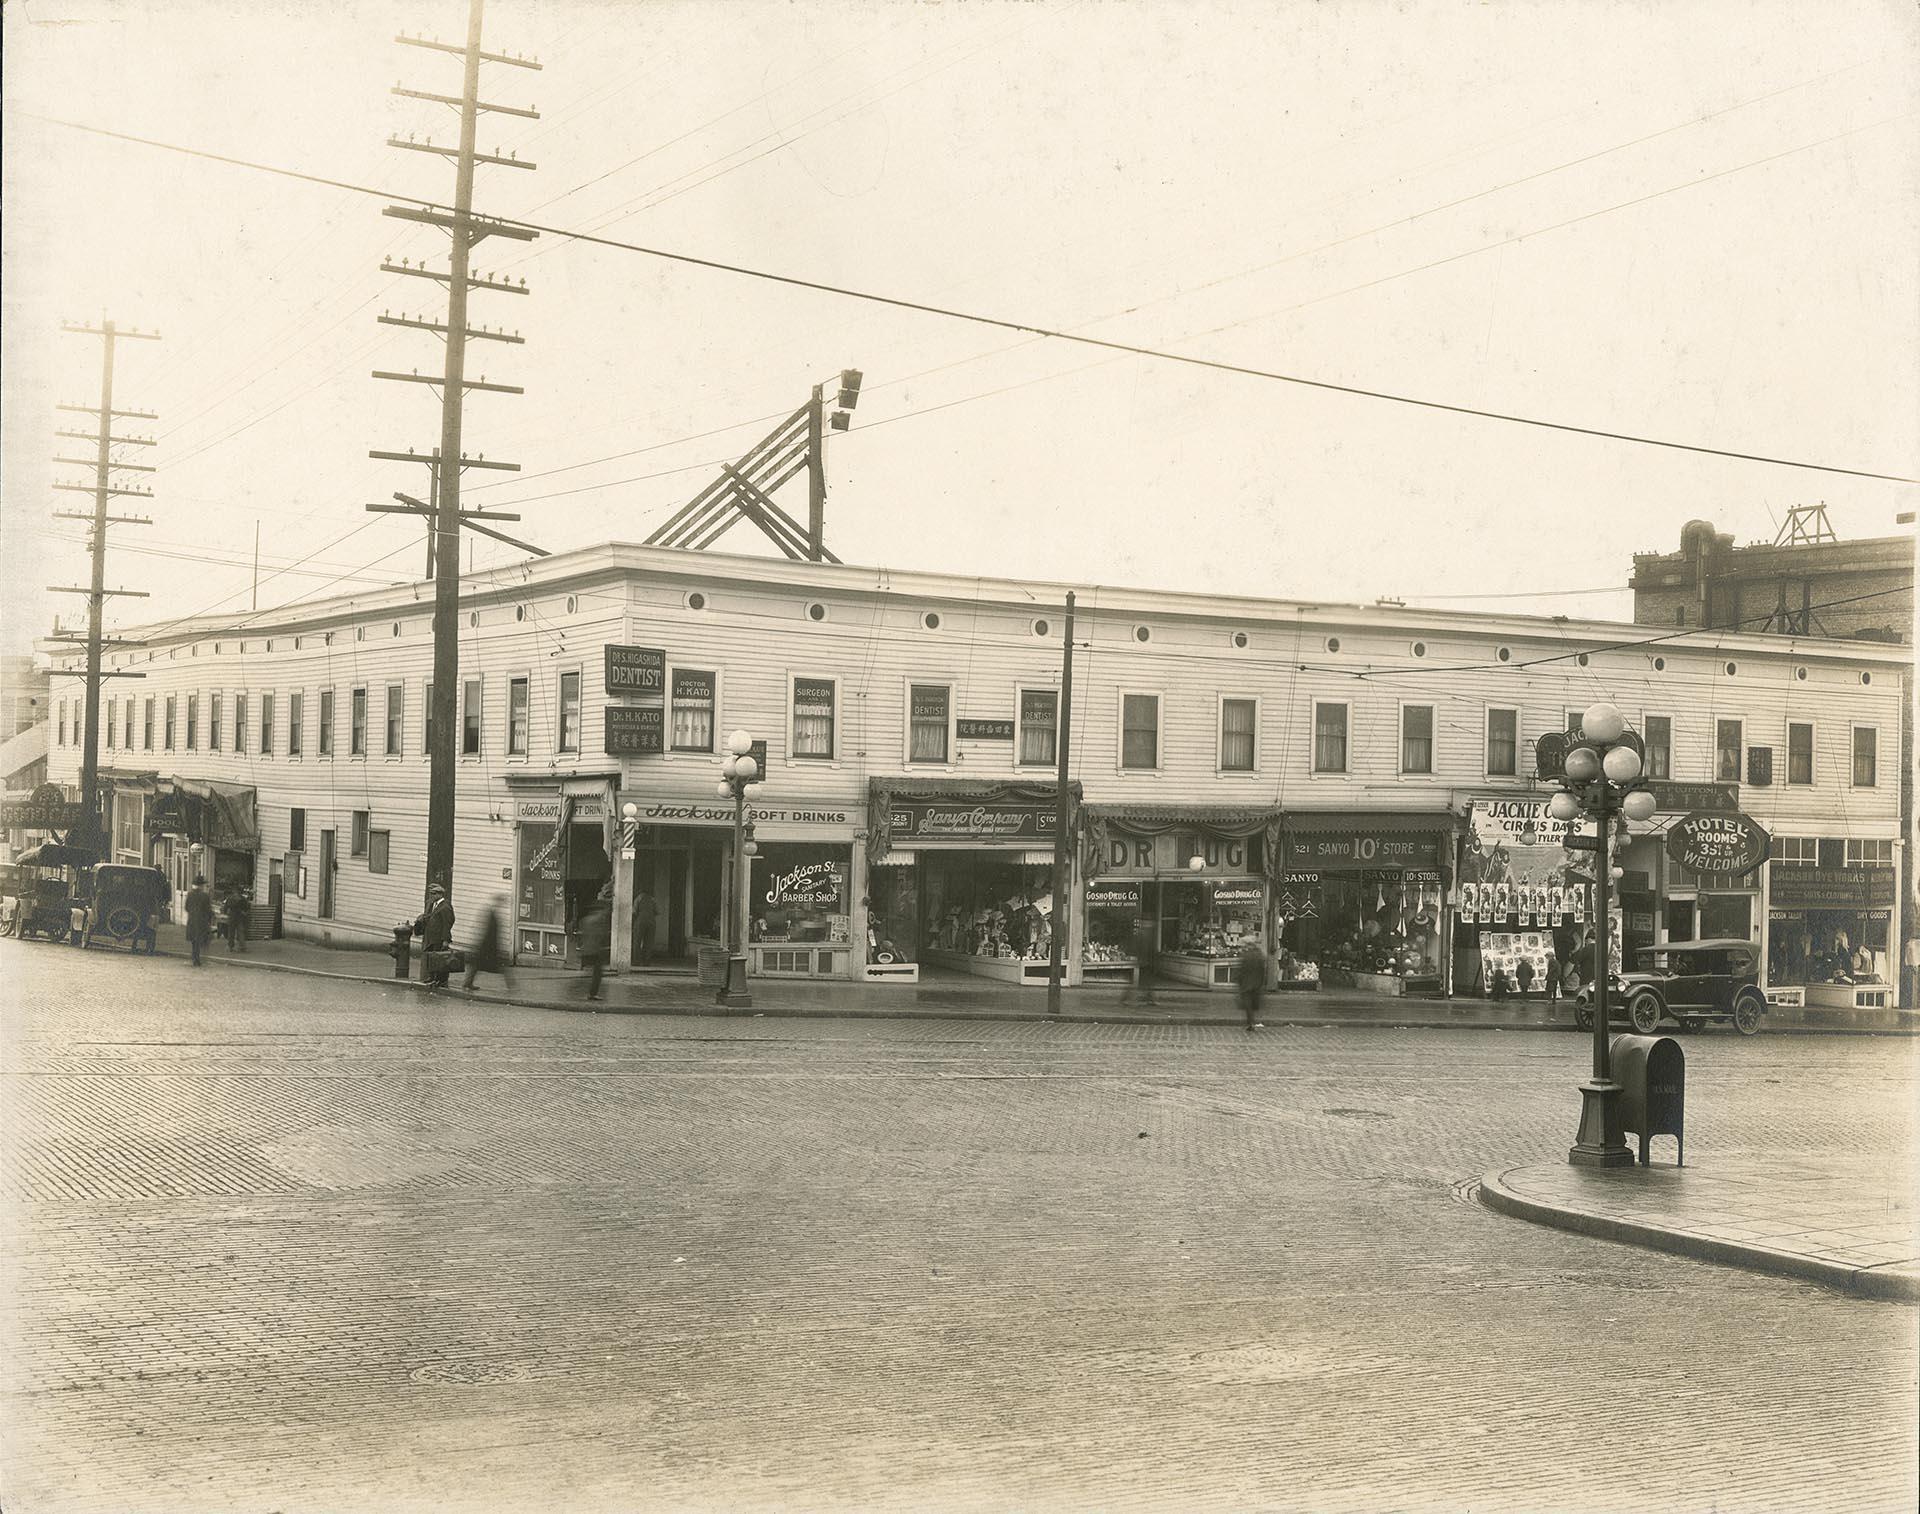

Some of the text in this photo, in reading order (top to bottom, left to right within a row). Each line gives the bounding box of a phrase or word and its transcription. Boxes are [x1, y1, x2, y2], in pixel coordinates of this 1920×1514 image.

[612, 666, 661, 686] DENTIST
[797, 688, 831, 697] SURGEON
[914, 705, 944, 715] DENTIST
[1025, 712, 1052, 720] DENTIST
[522, 803, 559, 816] Jackson
[646, 804, 846, 823] Jackson SOFT DRINKS
[1488, 802, 1541, 819] JACKIE
[922, 808, 969, 830] Sanyo
[969, 807, 1032, 830] Company
[1552, 821, 1588, 833] DAS"
[1683, 818, 1750, 838] HOTEL
[1697, 832, 1738, 844] ROOMS
[1317, 843, 1350, 856] SANYO
[1383, 842, 1415, 855] STORE
[1683, 850, 1750, 870] WELCOME
[766, 861, 838, 903] Jackson St.
[1284, 873, 1319, 883] SANYO
[1365, 871, 1400, 881] SANYO
[1417, 872, 1441, 881] STORE
[1834, 872, 1865, 883] WORKS
[801, 878, 827, 893] SANITARY
[782, 892, 814, 902] BARBER
[1869, 911, 1888, 919] GOODS
